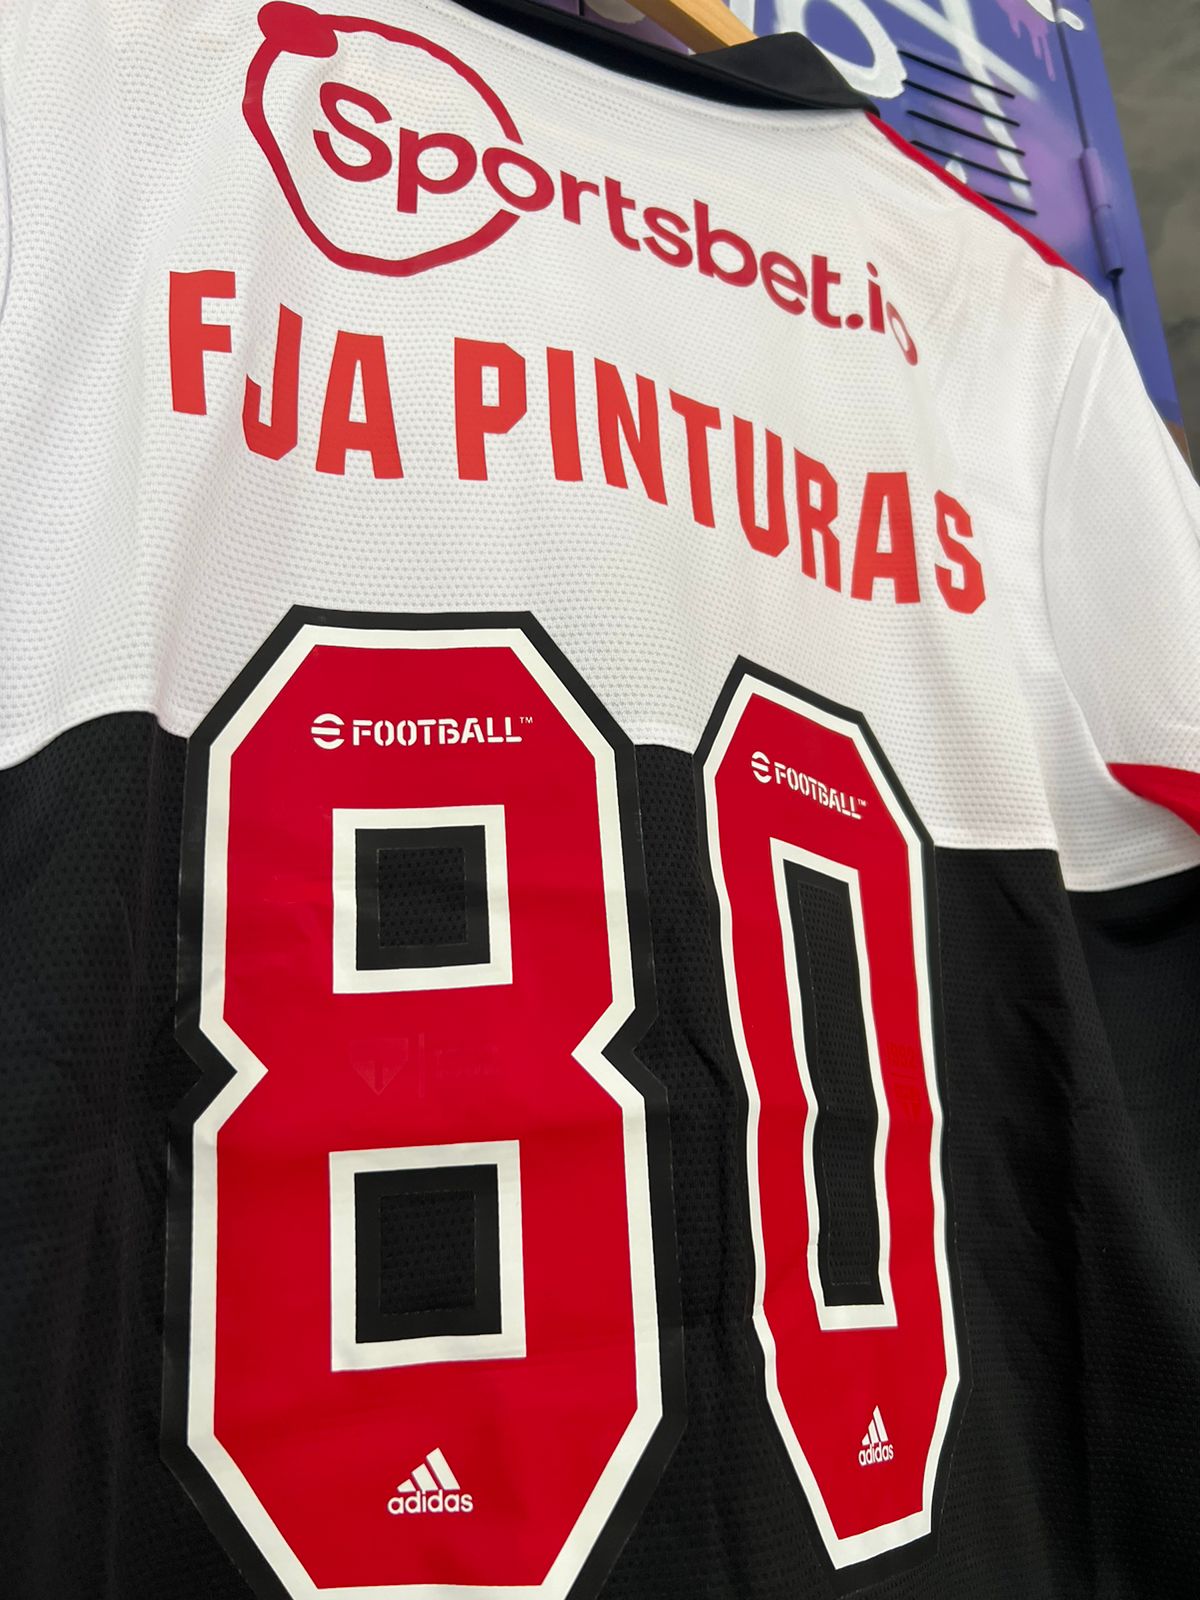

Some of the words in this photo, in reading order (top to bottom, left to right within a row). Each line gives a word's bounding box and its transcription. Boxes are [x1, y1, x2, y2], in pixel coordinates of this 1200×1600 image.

[313, 82, 919, 367] Sportsbet.io
[168, 270, 404, 480] FJA
[453, 337, 987, 615] PINTURAS
[187, 624, 962, 1600] 80
[387, 1489, 474, 1515] adidas
[858, 1441, 895, 1467] adidas
